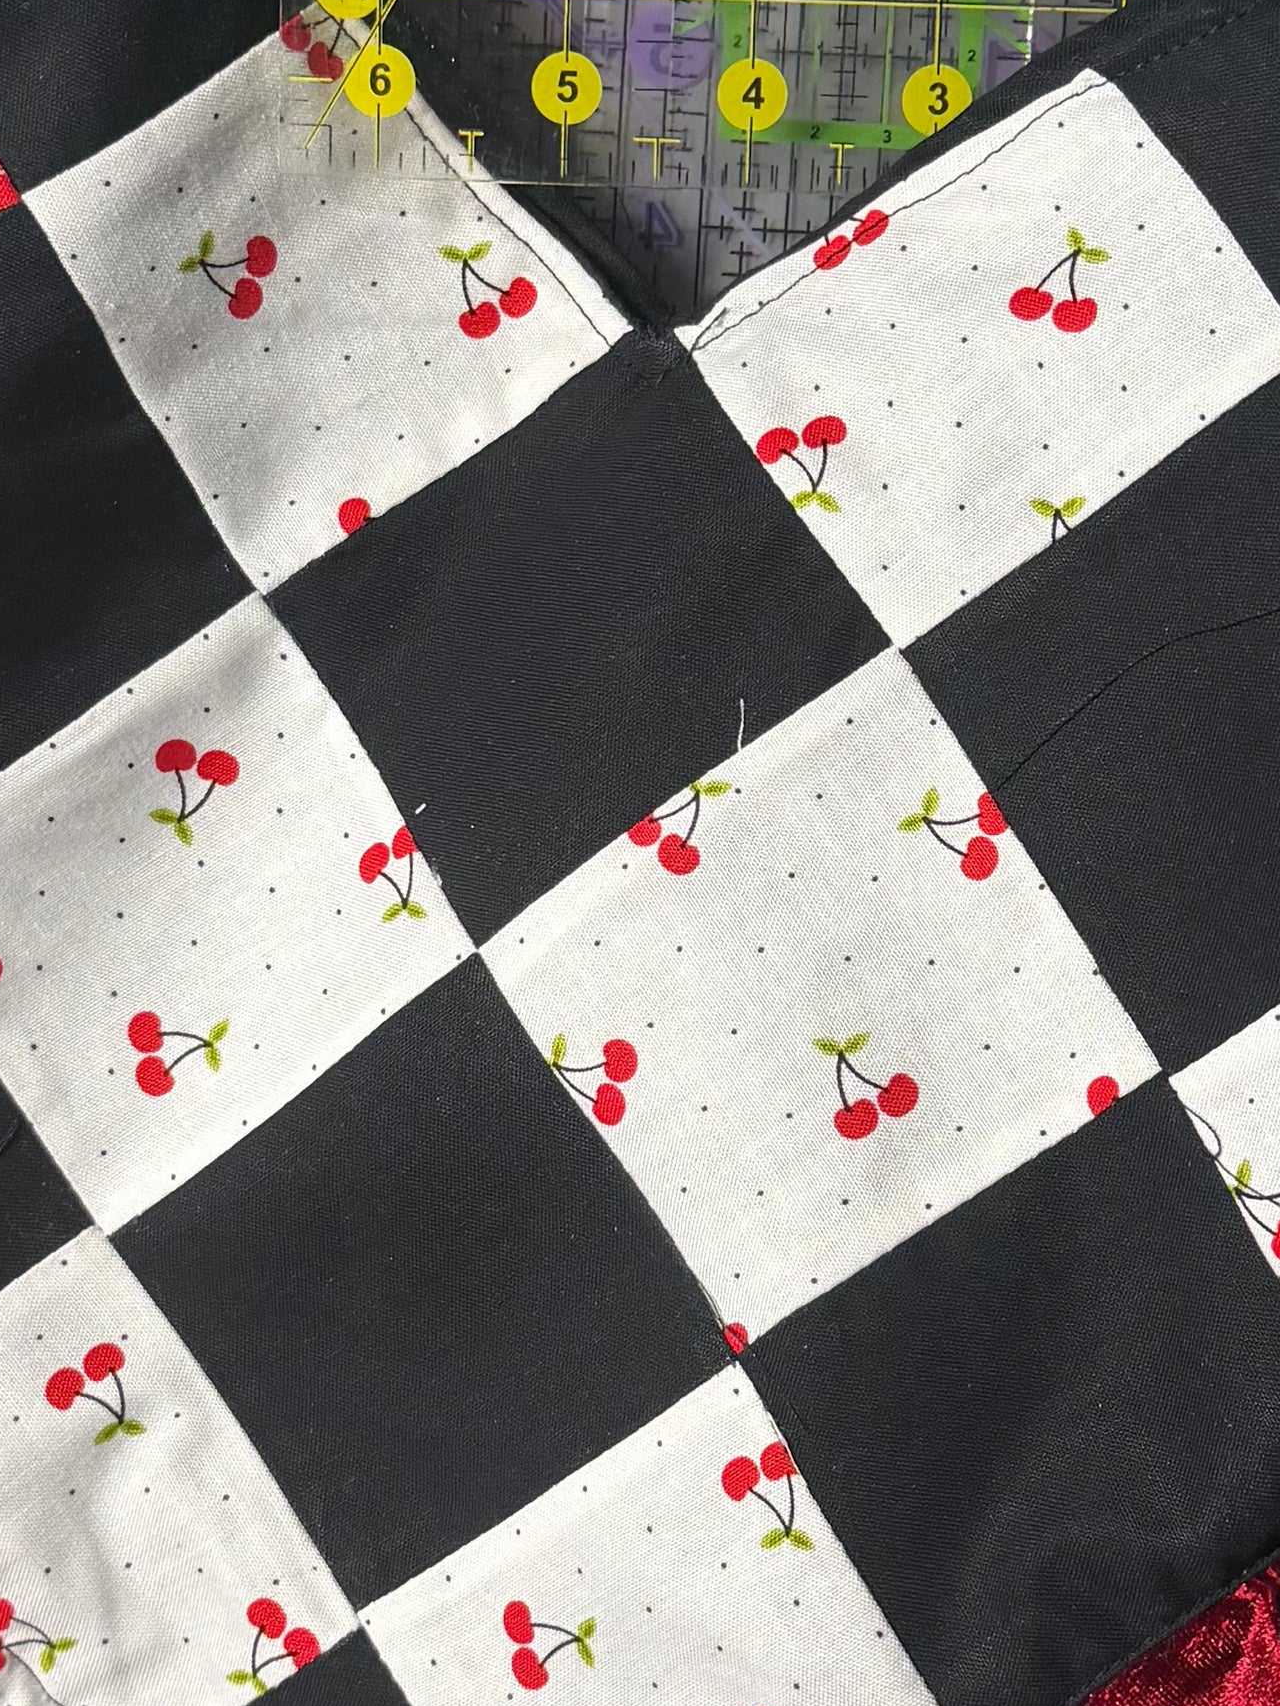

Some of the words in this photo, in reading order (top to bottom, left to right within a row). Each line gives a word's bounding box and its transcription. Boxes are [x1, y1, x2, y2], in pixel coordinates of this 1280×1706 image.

[967, 48, 977, 63] 2
[369, 63, 392, 97] 6
[557, 71, 579, 103] 5
[741, 77, 765, 110] 4
[928, 83, 949, 116] 3
[810, 126, 821, 140] 2
[883, 128, 893, 143] 3
